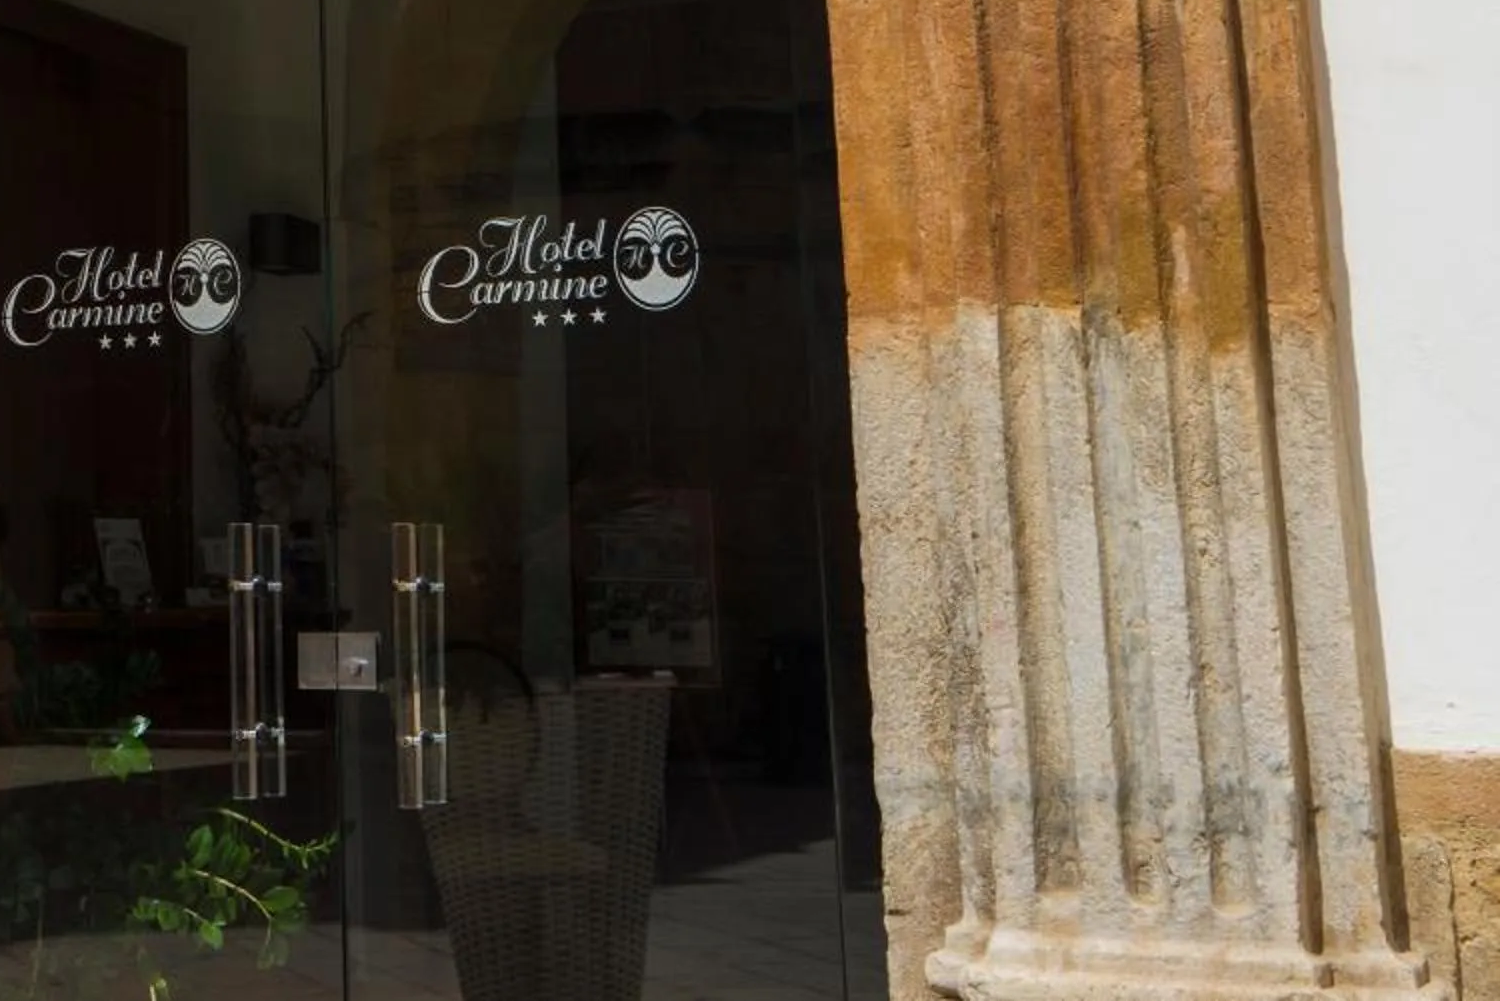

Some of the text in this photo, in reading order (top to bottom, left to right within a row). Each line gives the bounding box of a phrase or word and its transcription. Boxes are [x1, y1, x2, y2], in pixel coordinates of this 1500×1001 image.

[54, 246, 164, 304] Hotel
[474, 214, 607, 278] Hotel
[1, 273, 164, 346] Carmine
[417, 245, 608, 324] Carmine
